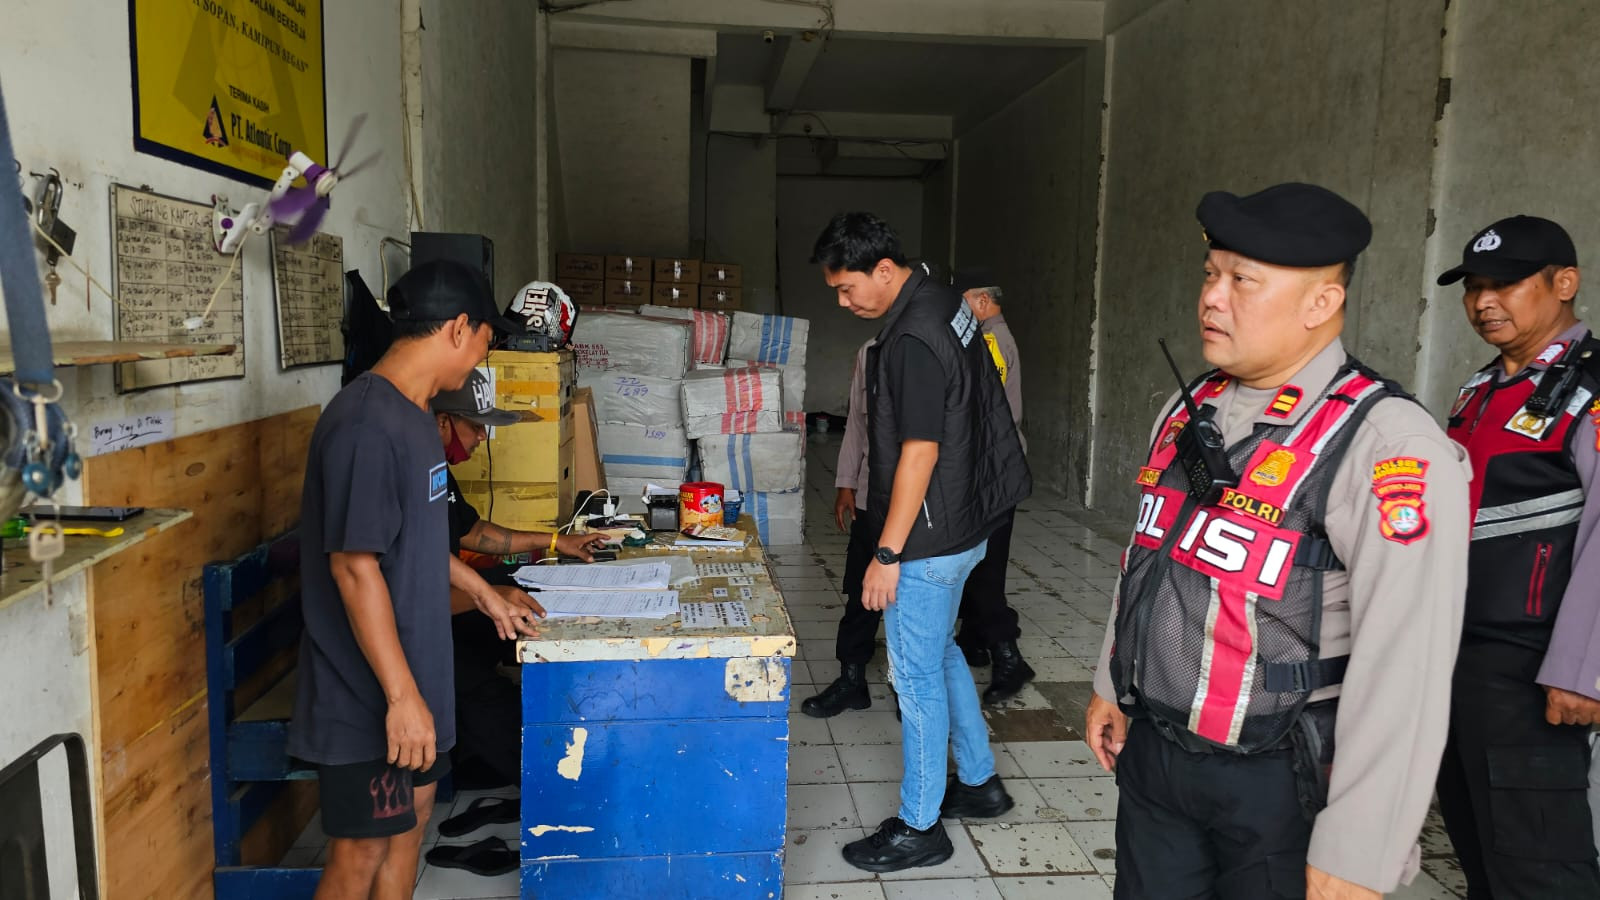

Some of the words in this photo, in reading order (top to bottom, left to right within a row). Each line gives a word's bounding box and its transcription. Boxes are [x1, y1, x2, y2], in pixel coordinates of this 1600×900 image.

[241, 21, 281, 56] KAMIPUN
[228, 84, 252, 104] TERIMA
[246, 118, 273, 151] Atlantic
[1224, 490, 1281, 524] POLRI
